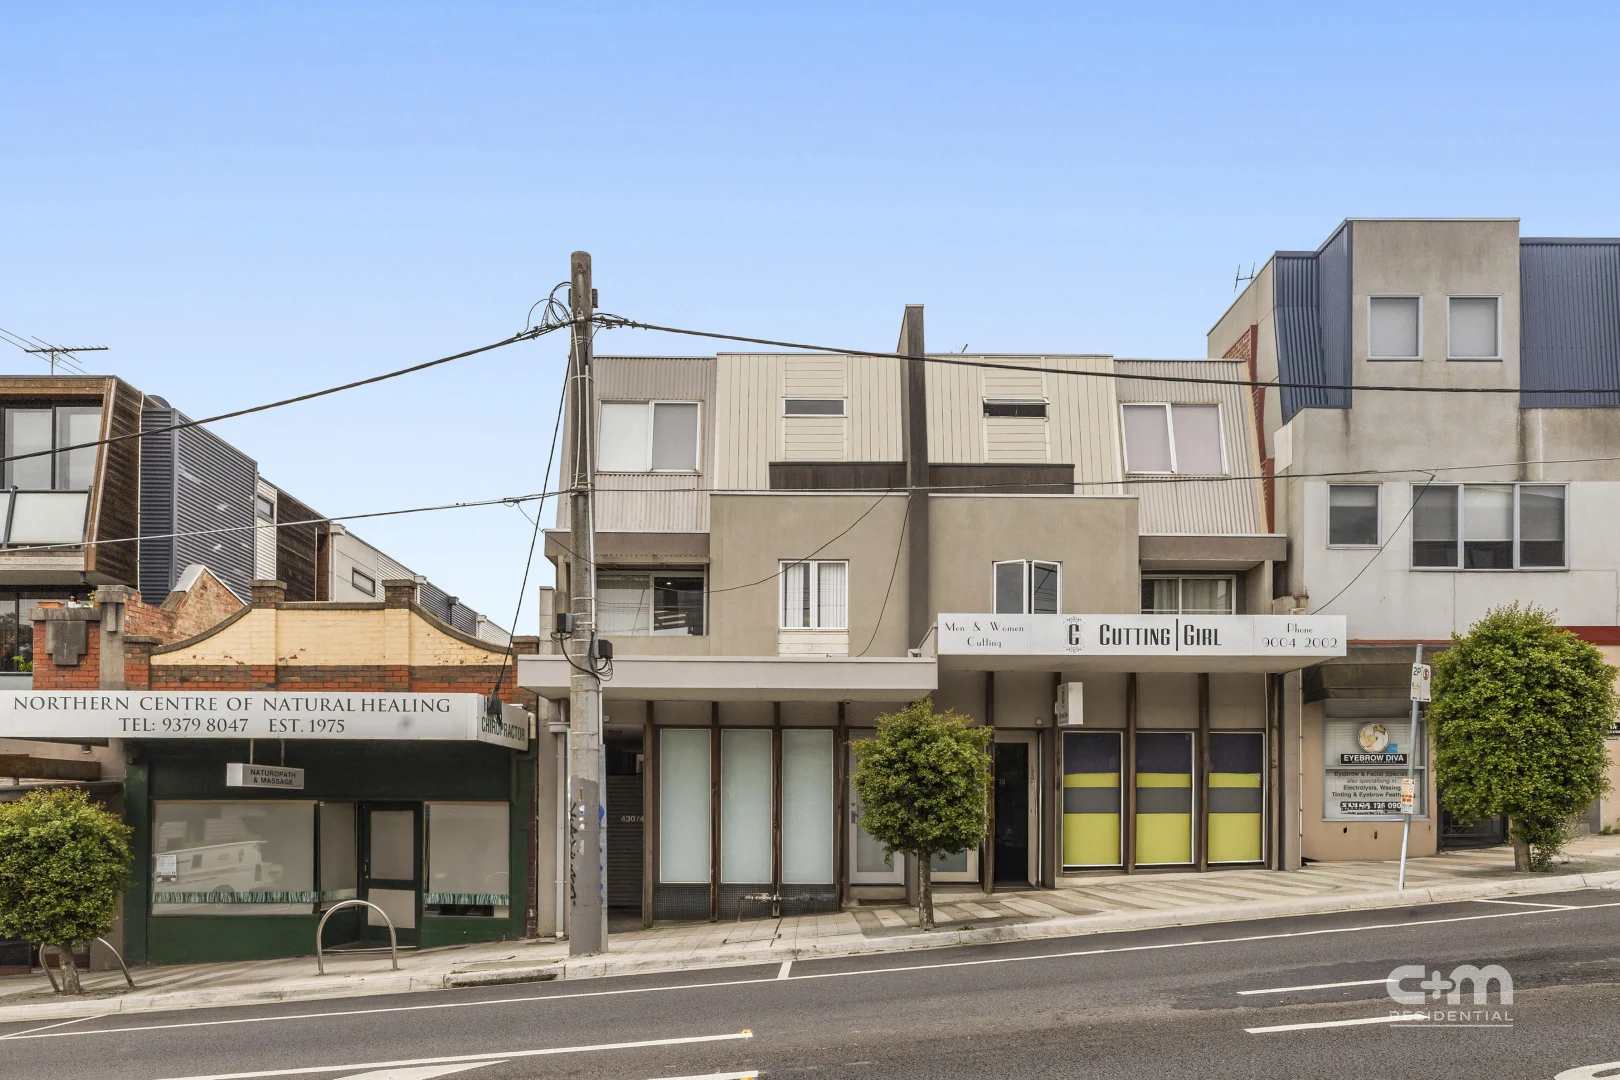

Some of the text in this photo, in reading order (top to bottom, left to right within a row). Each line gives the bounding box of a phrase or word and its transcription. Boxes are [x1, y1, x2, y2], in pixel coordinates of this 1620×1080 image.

[945, 621, 1024, 632] Men & Women
[1287, 623, 1313, 633] Phone
[1099, 624, 1223, 646] CUTTING GIRL
[967, 637, 1002, 648] Cutting
[1261, 637, 1338, 649] 9004 2002
[13, 696, 451, 713] NORTHERN CENTRE OF NATURAL HEALING
[118, 717, 345, 733] TEL: 9379 8047 EST. 1975
[481, 716, 526, 742] CHIRORACTOR
[1343, 754, 1384, 762] EYEBROW
[1385, 754, 1404, 762] DIVA
[250, 769, 296, 779] NATUROPATH
[260, 777, 294, 786] MASSAGE
[1332, 791, 1351, 799] Tinting
[1359, 791, 1384, 799] Eyebrow
